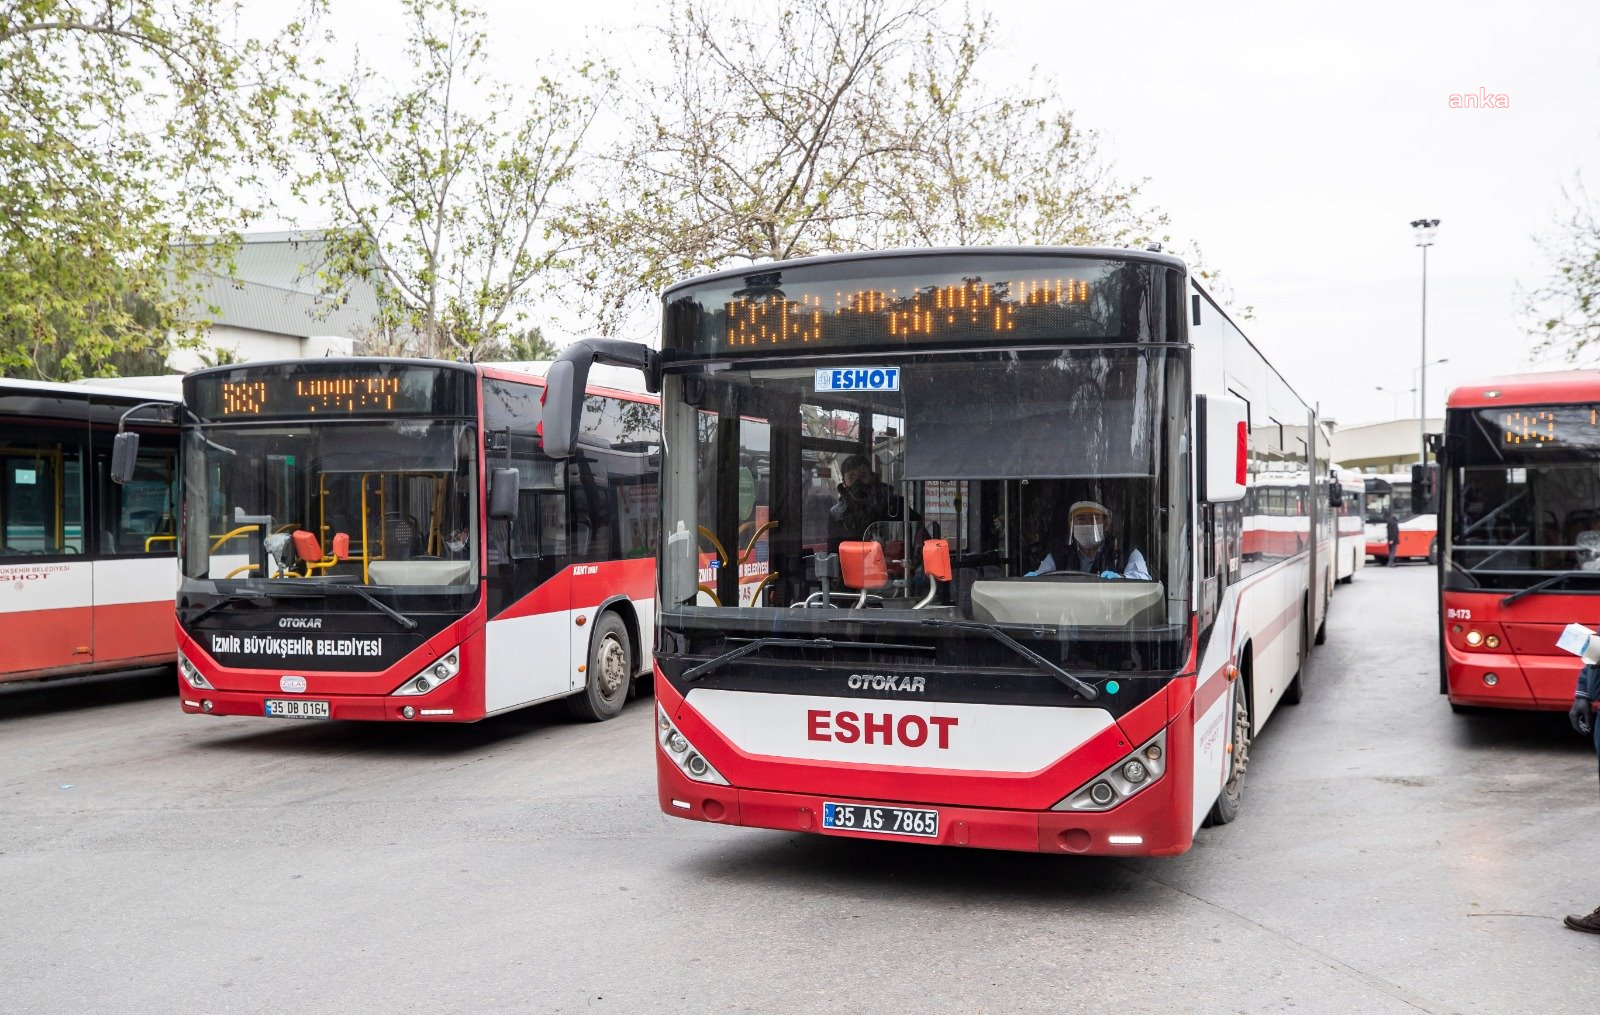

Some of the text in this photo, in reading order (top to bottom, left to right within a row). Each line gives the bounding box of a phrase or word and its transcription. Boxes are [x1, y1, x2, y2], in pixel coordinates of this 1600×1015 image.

[832, 369, 897, 389] ESHOT
[0, 566, 31, 575] ÜKŞEHİR
[279, 617, 322, 629] OTOKAR
[212, 634, 382, 659] İZMİR BÜYÜKŞEHİR BELEDİYESİ
[848, 674, 926, 693] OTOKAR
[272, 701, 327, 715] 35 DB 0164
[808, 709, 959, 750] ESHOT
[834, 807, 855, 827] 35
[863, 808, 883, 829] AS
[893, 810, 935, 833] 7865
